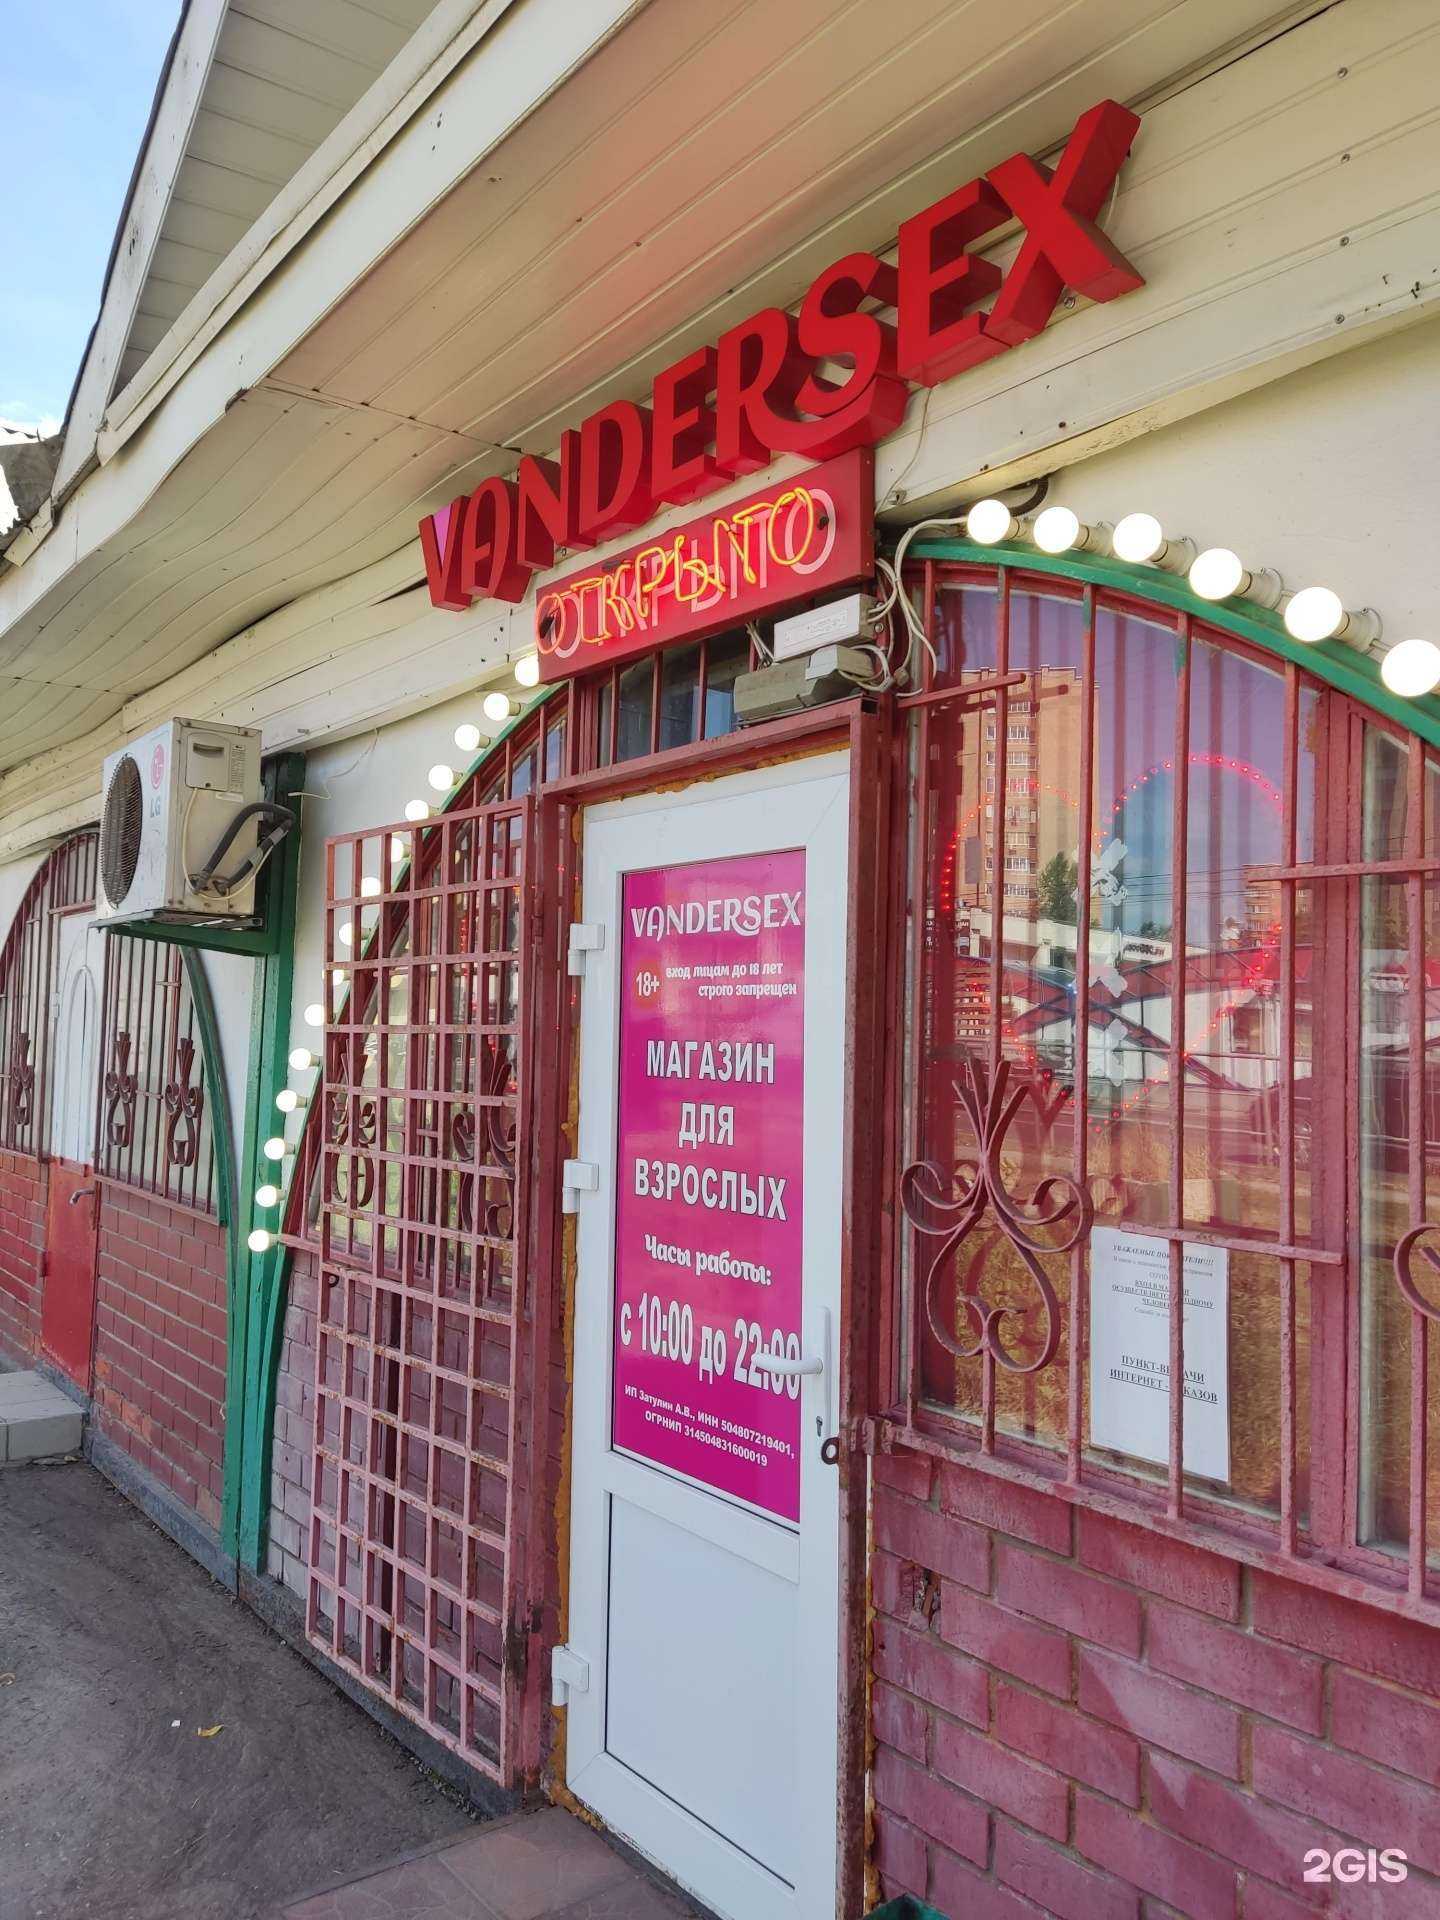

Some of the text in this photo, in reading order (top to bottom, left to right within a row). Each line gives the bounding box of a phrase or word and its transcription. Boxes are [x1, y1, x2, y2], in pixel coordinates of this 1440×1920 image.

[420, 99, 1144, 612] VANDERSEX
[535, 488, 836, 659] ОТКРЫТО
[150, 799, 161, 818] LG
[630, 891, 802, 942] VANDERSEX
[636, 972, 660, 997] 18+
[666, 962, 784, 980] вход лицам до 18 лет
[698, 983, 797, 1000] строго запрещен
[647, 1040, 775, 1083] МАГАЗИН
[678, 1102, 736, 1149] ДЛЯ
[634, 1158, 788, 1222] ВЗРОСЛЫХ
[644, 1233, 772, 1286] Часы работы:
[638, 1292, 694, 1366] 10:00
[699, 1325, 727, 1385] до
[734, 1318, 800, 1400] 22:00
[1109, 1368, 1165, 1390] ИНТЕРНЕТ
[624, 1384, 638, 1397] ИП
[639, 1390, 673, 1413] Затулин
[698, 1411, 719, 1429] ИНН
[645, 1410, 682, 1434] ОГРНИП
